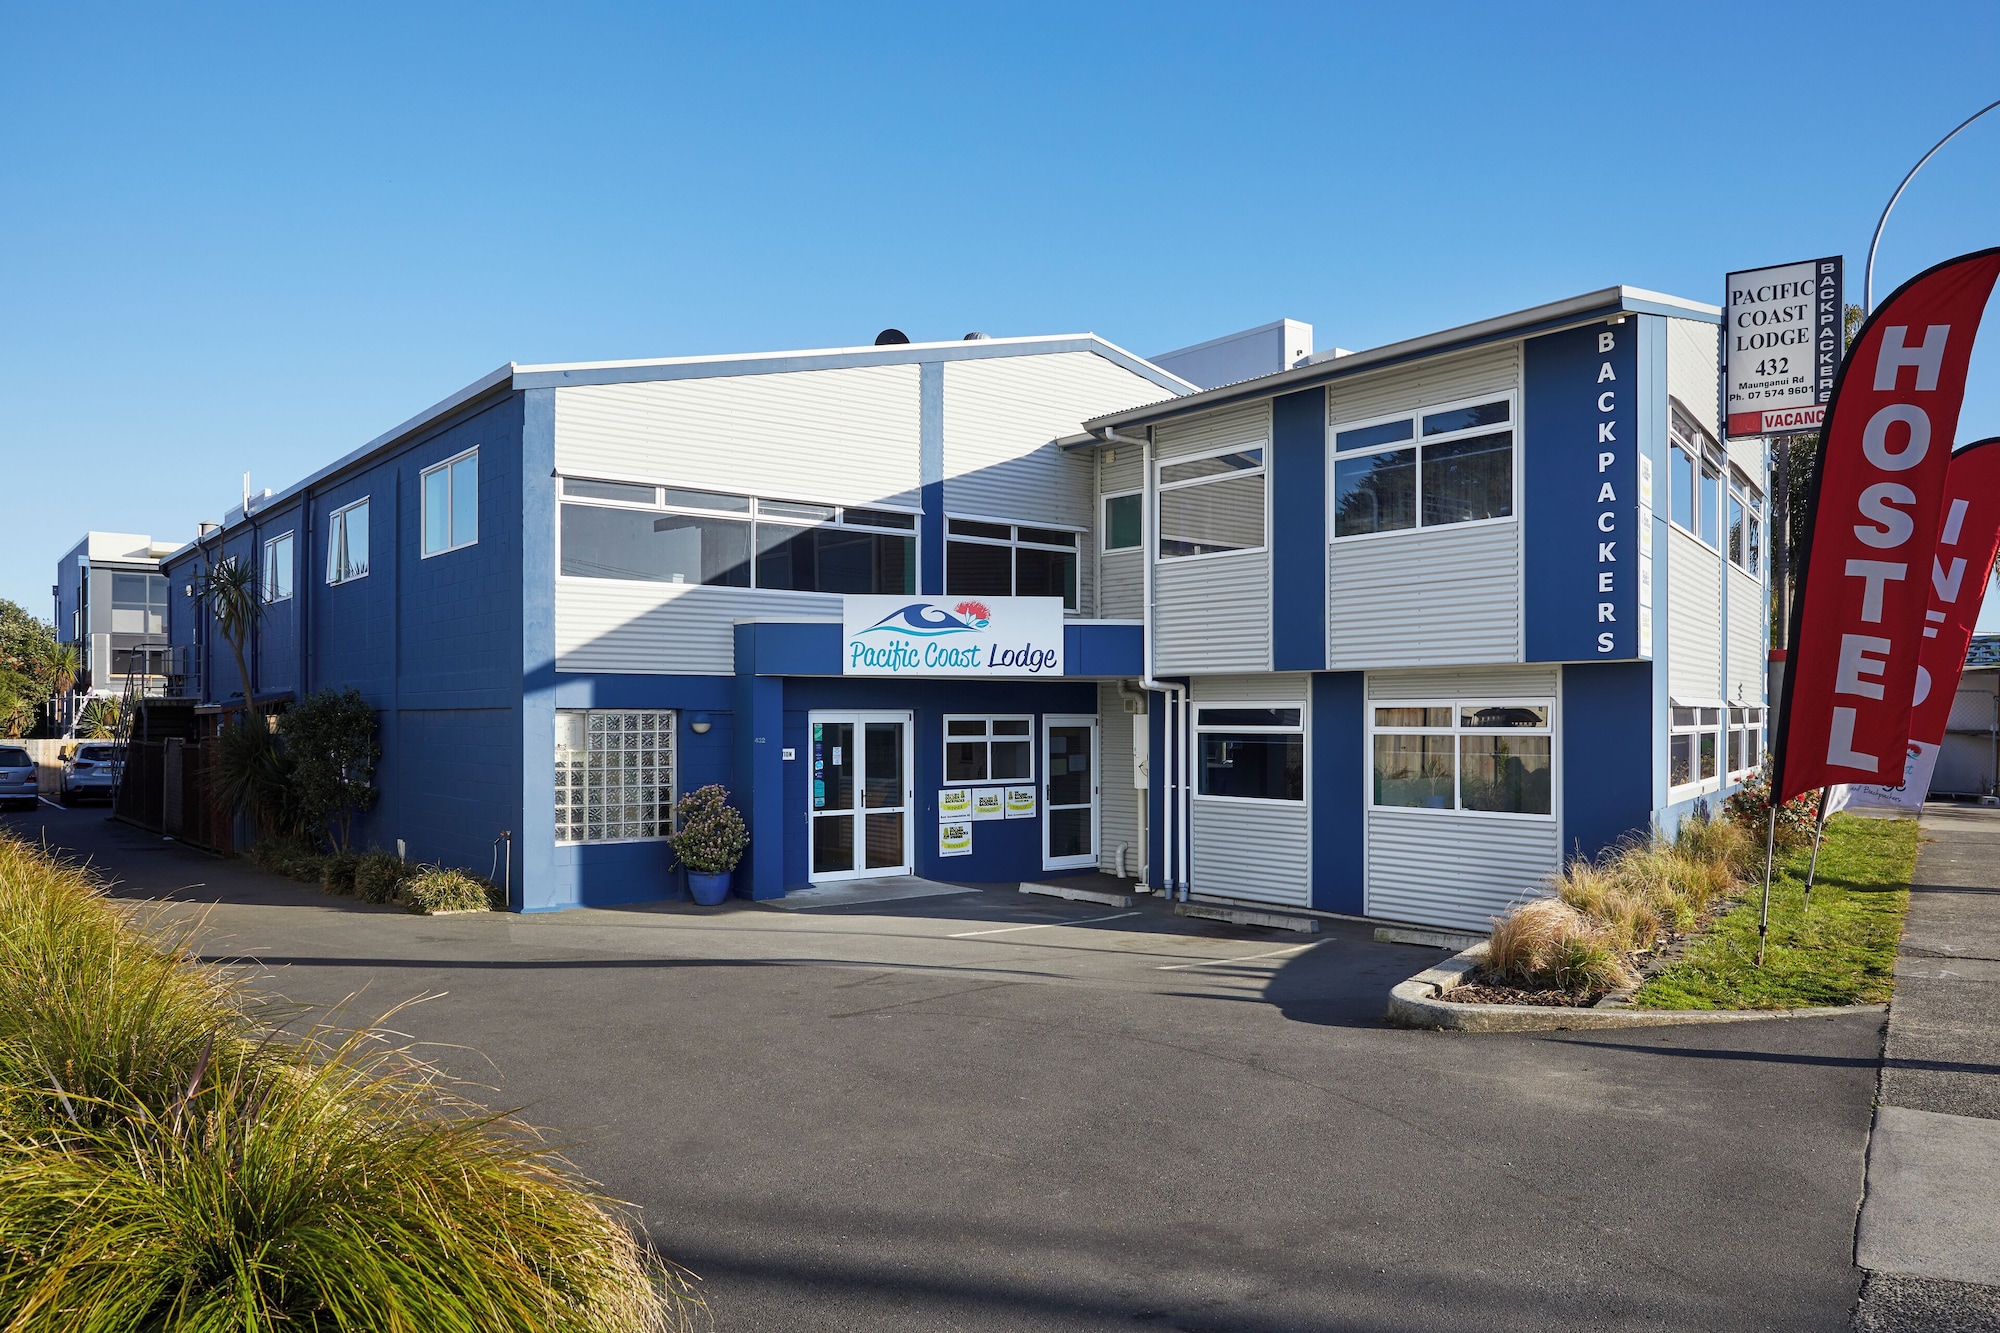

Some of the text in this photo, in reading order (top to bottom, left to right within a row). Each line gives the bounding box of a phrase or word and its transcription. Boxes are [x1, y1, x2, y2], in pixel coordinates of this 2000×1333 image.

[1731, 279, 1815, 306] PACIFIC
[1737, 304, 1808, 329] COAST
[1736, 327, 1810, 352] LODGE
[1819, 262, 1836, 403] BACKPACKERS
[1755, 357, 1789, 376] 432
[1729, 386, 1815, 402] Ph. 07 574 9601
[1738, 376, 1805, 391] Maunganui Rd
[1765, 410, 1825, 428] VACANC
[1597, 331, 1616, 653] BACKPACKERS
[1825, 323, 1951, 773] HOSTEL
[849, 640, 1057, 674] Pacific Coast Lodge
